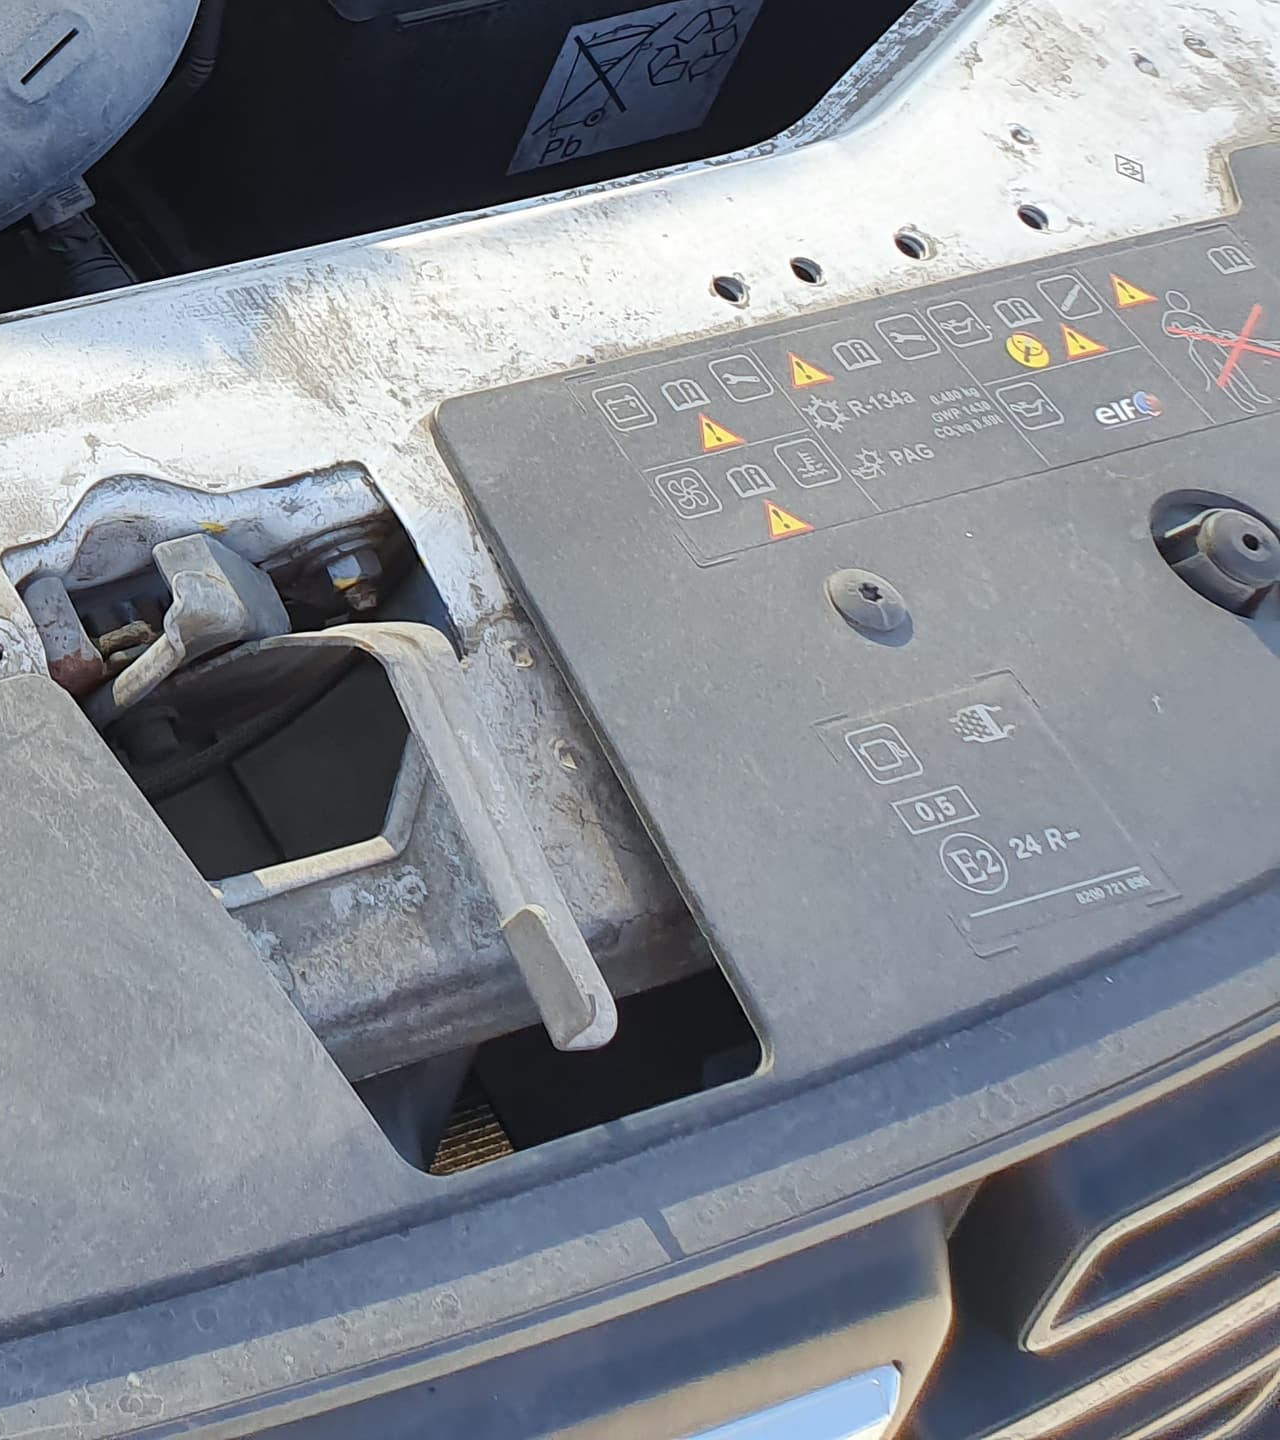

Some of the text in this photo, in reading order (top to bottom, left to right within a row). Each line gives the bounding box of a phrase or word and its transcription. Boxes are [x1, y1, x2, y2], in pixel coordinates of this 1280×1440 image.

[538, 133, 582, 164] Pb
[846, 390, 917, 417] R-134a
[931, 408, 961, 423] GWP
[1095, 398, 1136, 425] elf
[888, 443, 935, 466] PAG
[914, 796, 957, 823] 0,5
[1008, 837, 1042, 860] 24
[947, 847, 1002, 886] E2
